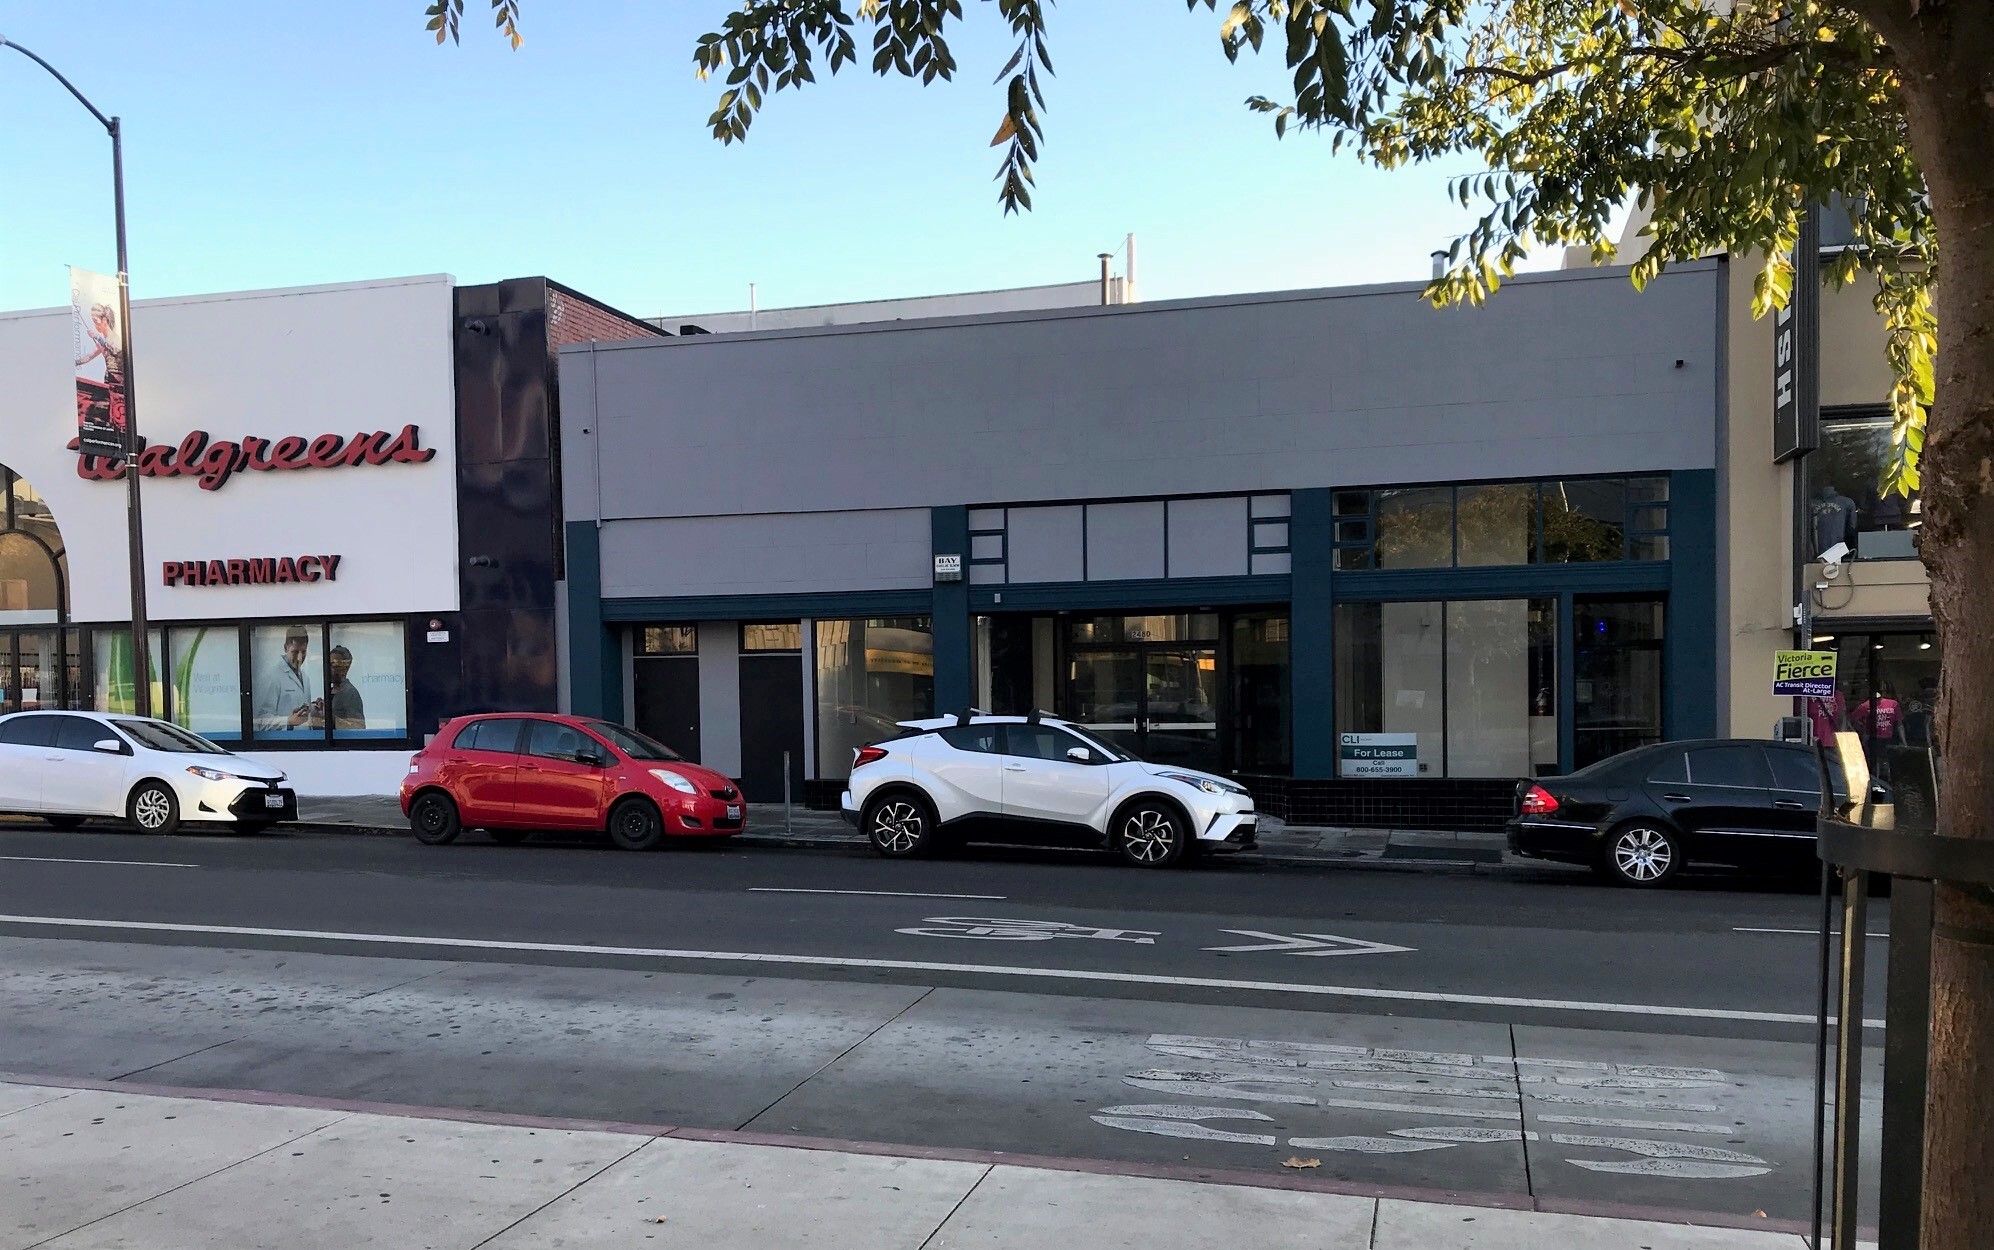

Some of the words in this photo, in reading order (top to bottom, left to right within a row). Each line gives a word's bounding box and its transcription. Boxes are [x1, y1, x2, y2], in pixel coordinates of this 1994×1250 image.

[162, 554, 341, 588] PHARMACY
[1132, 630, 1151, 638] 2480
[1777, 653, 1813, 663] Victoria
[1776, 663, 1833, 680] Fierce
[361, 673, 405, 685] pharmacy
[1804, 682, 1832, 690] Director
[1341, 735, 1360, 744] CLI
[1354, 749, 1371, 757] For
[1374, 749, 1404, 757] Lease
